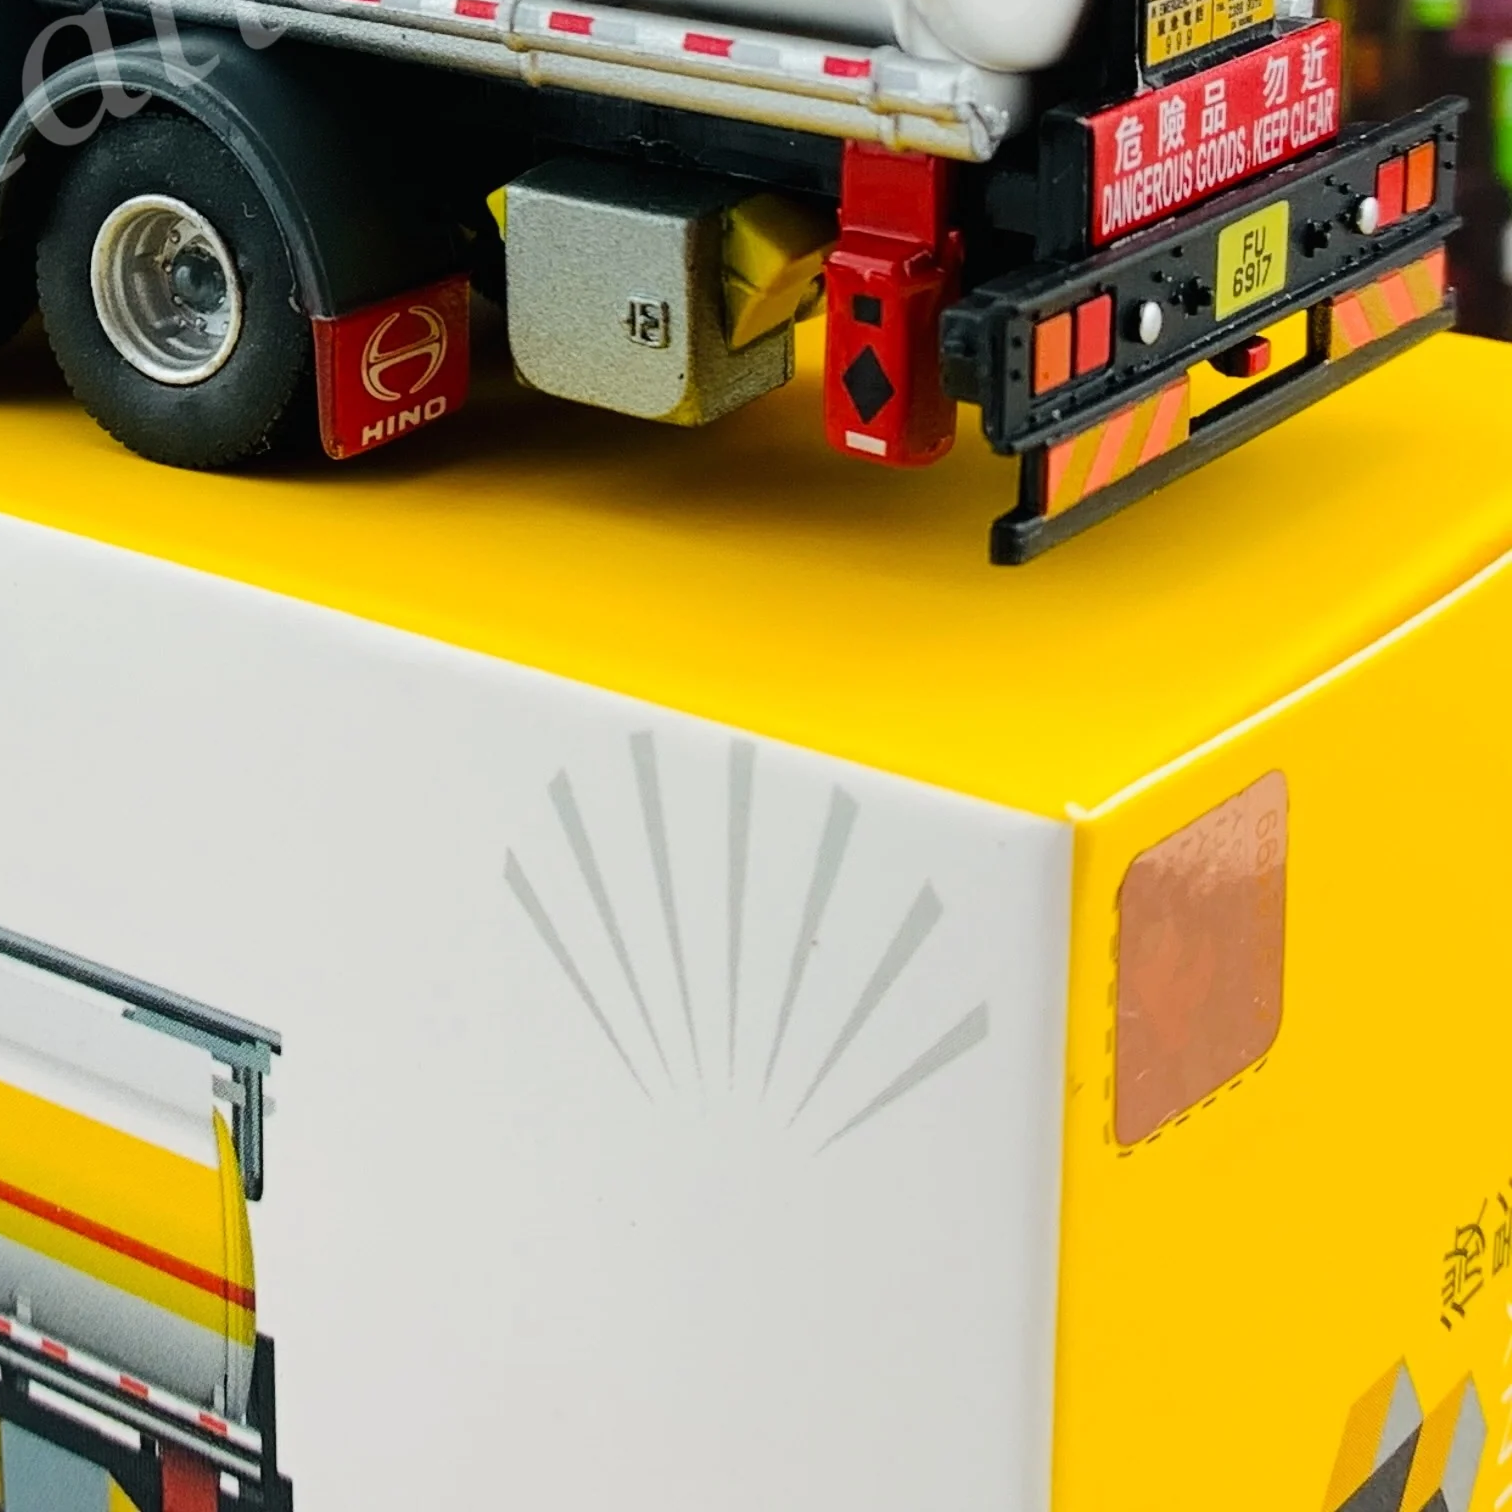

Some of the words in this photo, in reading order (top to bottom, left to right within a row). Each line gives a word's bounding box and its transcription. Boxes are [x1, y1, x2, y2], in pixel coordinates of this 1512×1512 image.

[1114, 78, 1227, 175] 危險品
[1262, 35, 1329, 109] 勿近
[1101, 148, 1193, 236] DANGEROUS
[1252, 109, 1289, 167] KEEP
[1290, 88, 1335, 149] CLEAR
[1242, 225, 1266, 265] FU
[1232, 253, 1273, 298] 6917
[361, 395, 447, 446] HINO
